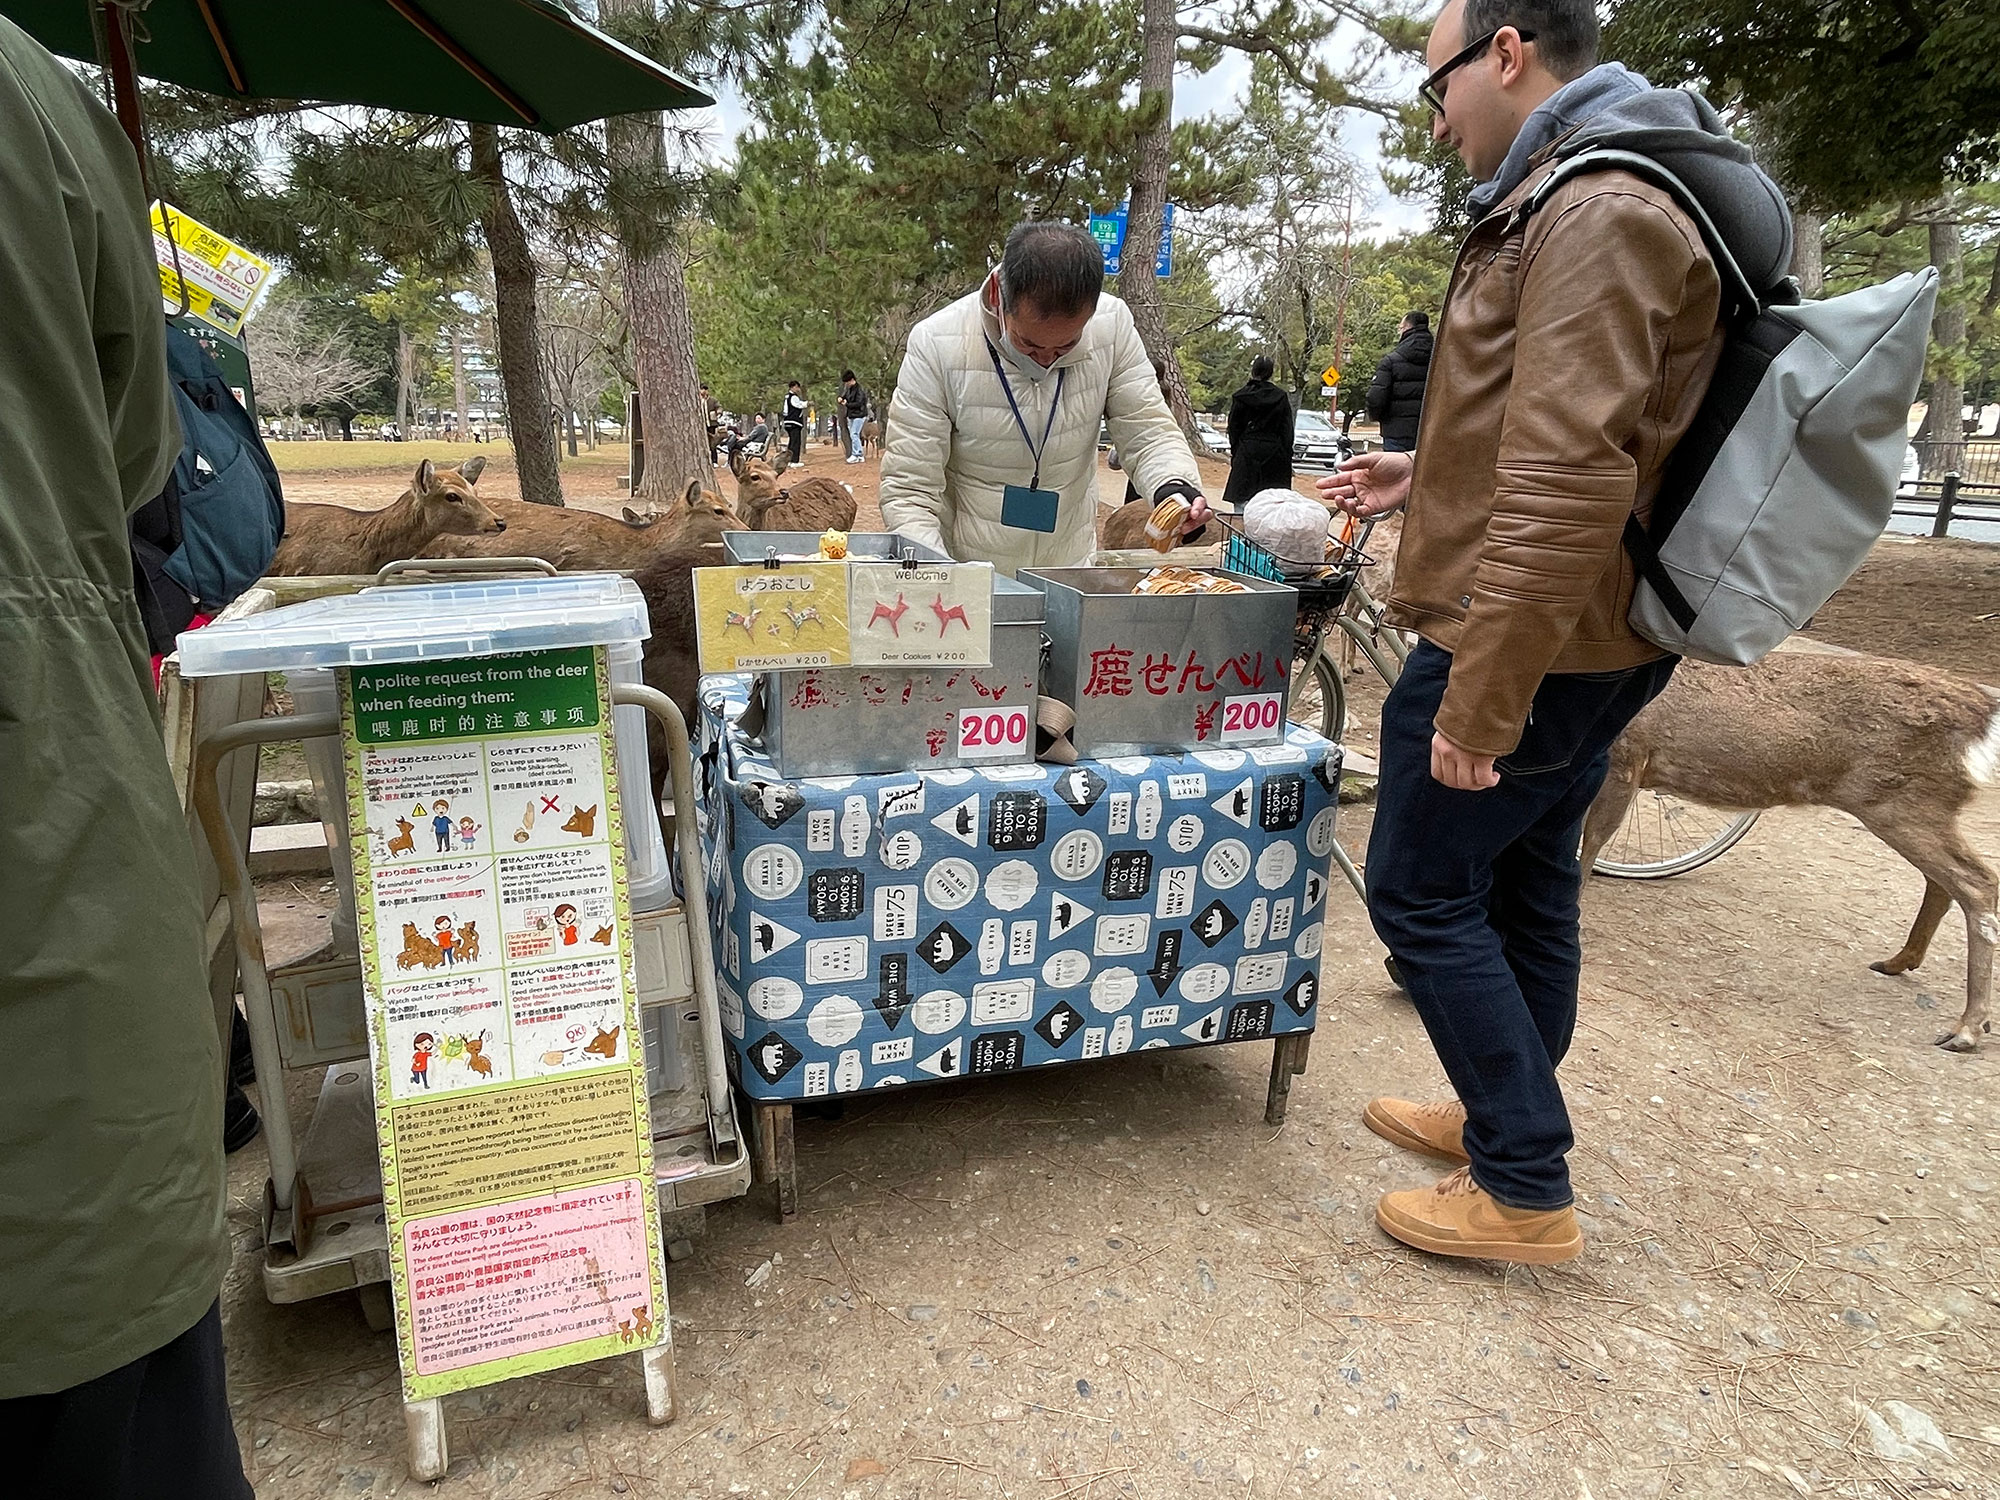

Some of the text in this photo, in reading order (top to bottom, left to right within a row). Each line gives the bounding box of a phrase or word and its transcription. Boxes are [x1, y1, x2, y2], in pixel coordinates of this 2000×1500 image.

[740, 578, 811, 592] ようおこし
[895, 569, 948, 580] welcome
[358, 664, 588, 692] A polite request from the deer
[1083, 643, 1286, 698] 鹿せんべい
[360, 690, 515, 712] when feeding them:
[371, 706, 585, 738] 喂鹿时的注意事项
[1224, 699, 1279, 732] 200
[962, 713, 1026, 746] 200
[435, 771, 479, 780] accompanied
[1281, 796, 1290, 811] TO
[812, 819, 820, 843] 20km
[822, 818, 830, 843] NEXT
[1015, 814, 1025, 829] TO
[1179, 819, 1194, 847] STOP
[896, 836, 910, 865] STOP
[378, 888, 402, 896] around
[387, 880, 413, 888] mindful
[534, 878, 551, 886] raising
[936, 879, 956, 899] ENTER
[953, 875, 967, 890] NOT
[1169, 869, 1186, 891] 75
[829, 888, 838, 902] TO
[887, 888, 905, 912] 75
[1166, 891, 1175, 915] SPEED
[1175, 892, 1184, 913] LIMIT
[886, 912, 894, 937] SPEED
[1014, 930, 1022, 956] NEXT
[1159, 938, 1174, 980] ONE WAY
[888, 962, 898, 1011] ONE WAY
[502, 1235, 539, 1248] designated
[554, 1226, 582, 1236] National
[584, 1221, 608, 1231] Natural
[480, 1323, 494, 1331] Park
[525, 1312, 551, 1320] animals.
[623, 1291, 642, 1299] attack
[421, 1342, 445, 1352] people
[457, 1335, 478, 1344] please
